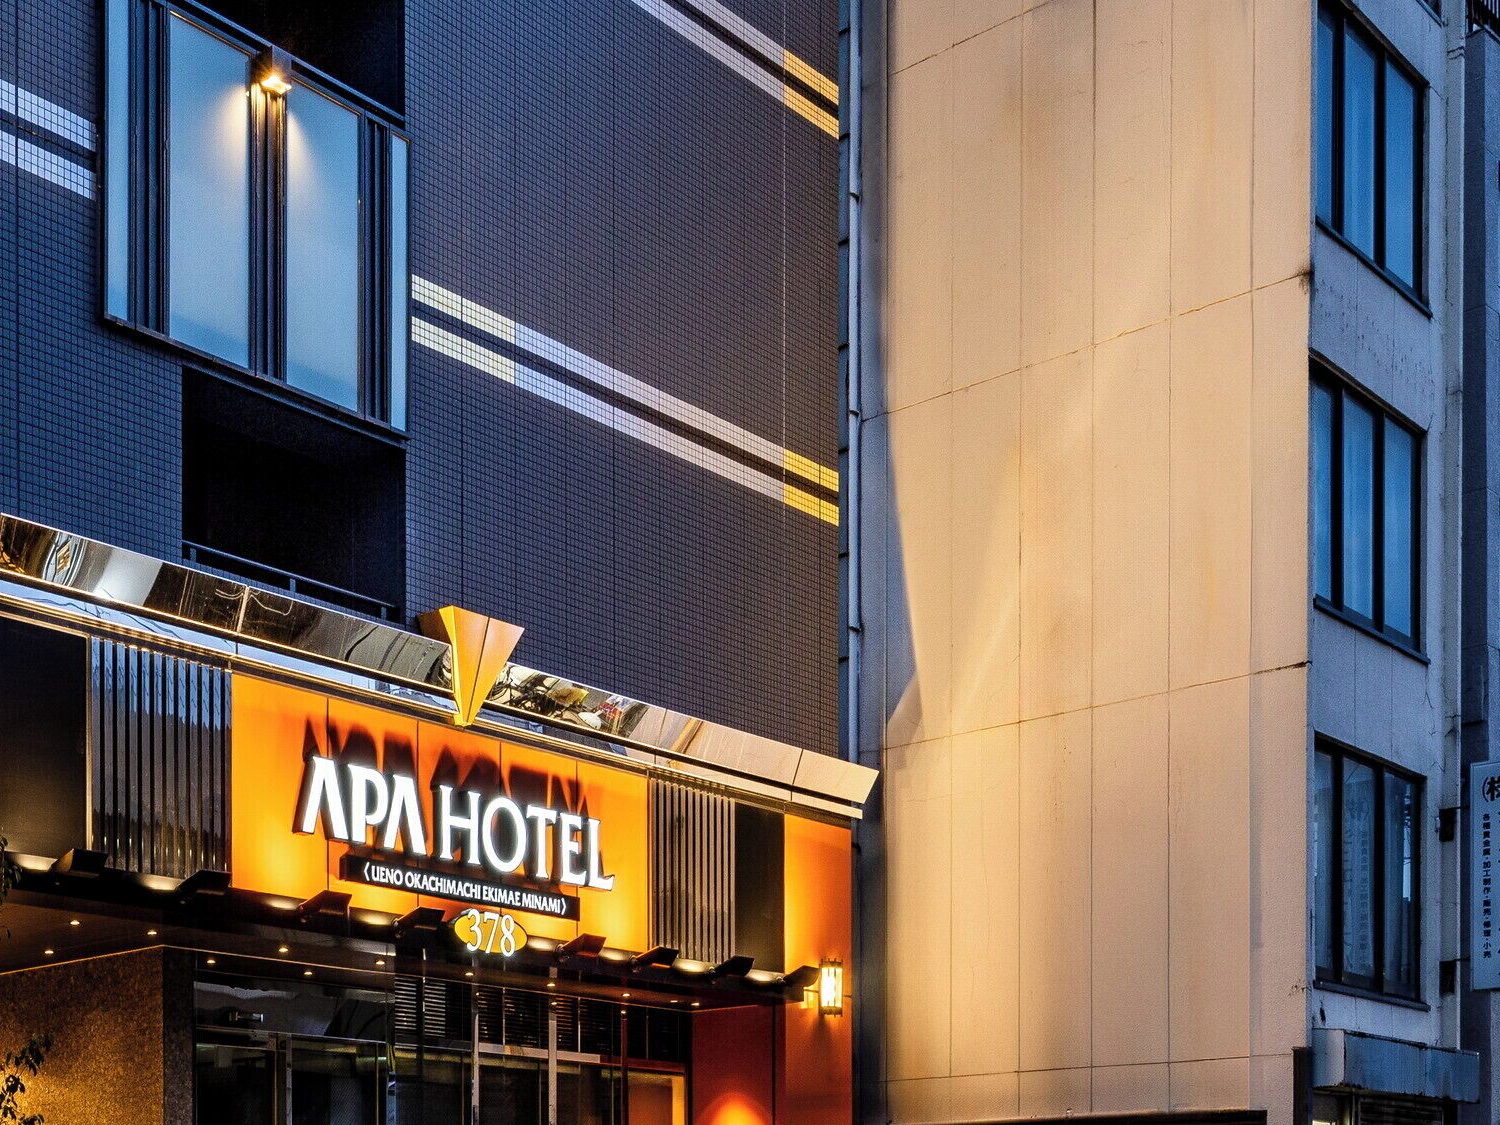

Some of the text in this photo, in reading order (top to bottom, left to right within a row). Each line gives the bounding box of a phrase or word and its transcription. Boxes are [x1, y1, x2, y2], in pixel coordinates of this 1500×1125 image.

[300, 755, 616, 892] APA HOTEL
[404, 871, 482, 901] OKACHIMACHI
[482, 885, 522, 908] EKIMAE
[465, 908, 516, 958] 378
